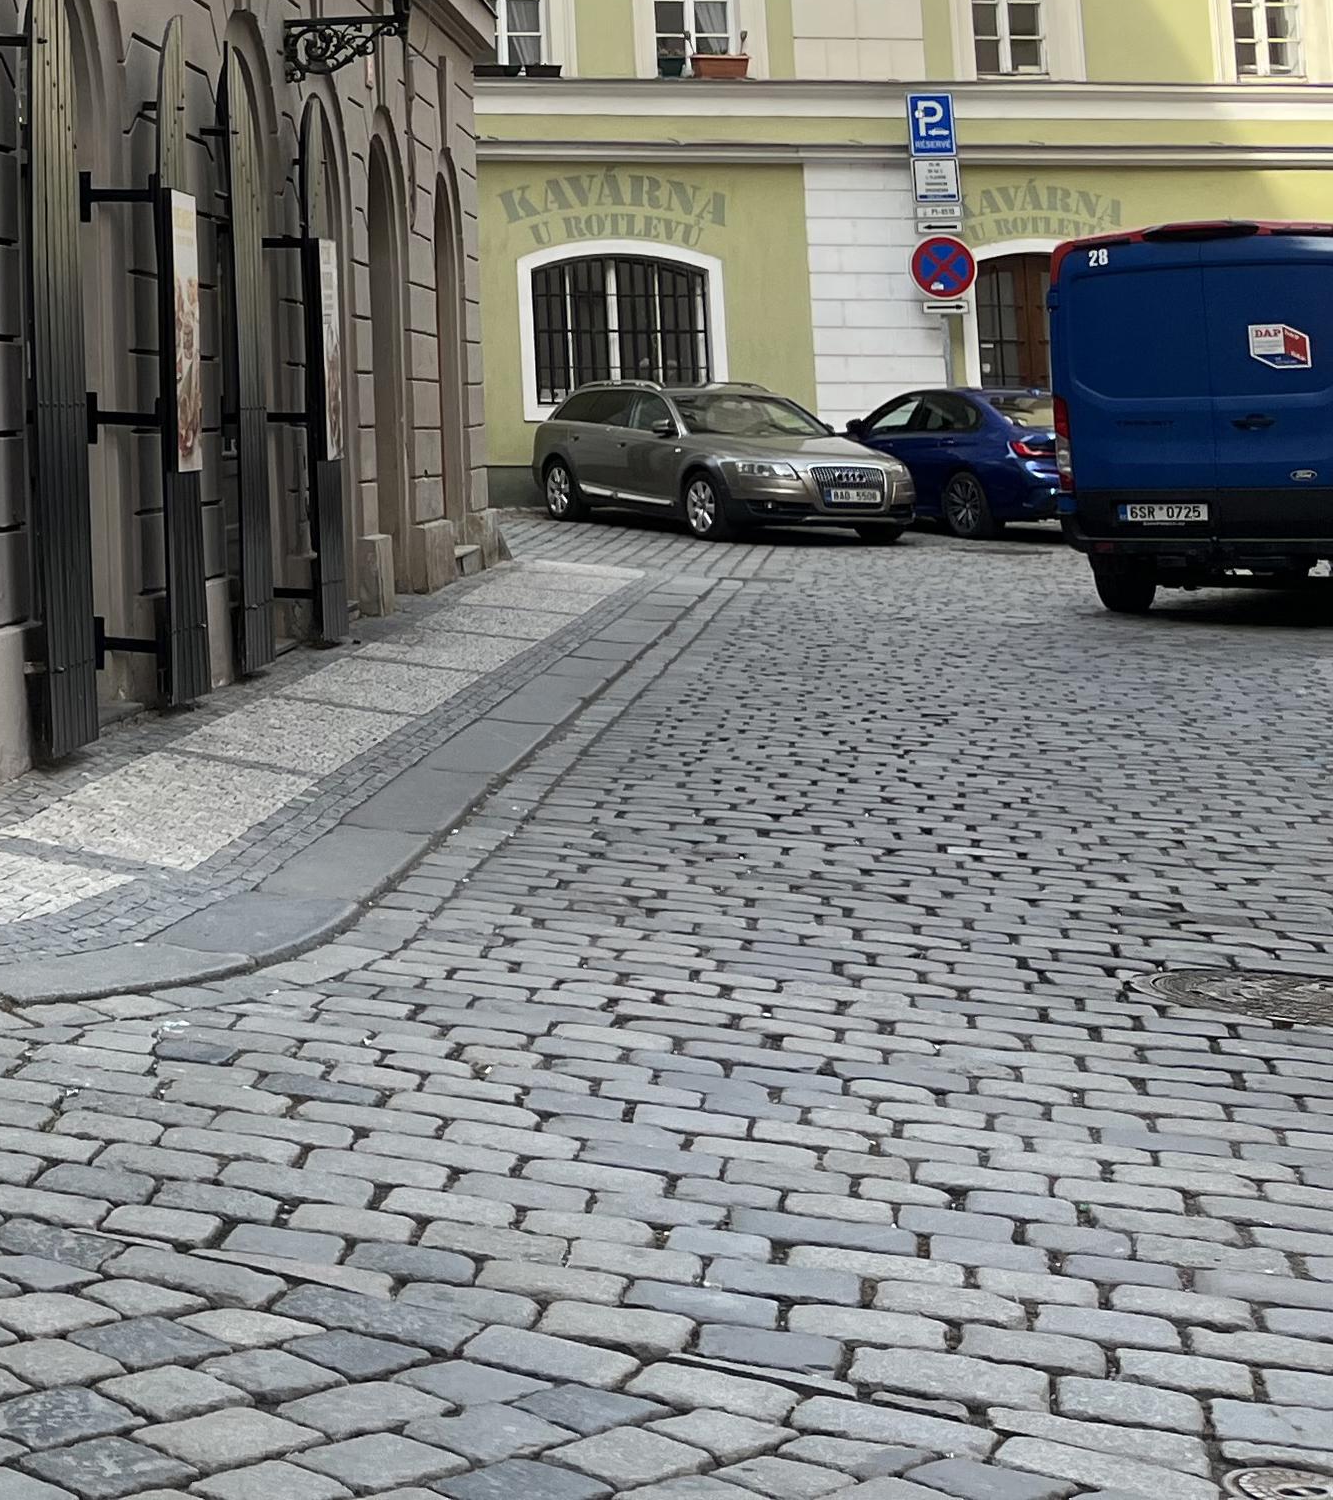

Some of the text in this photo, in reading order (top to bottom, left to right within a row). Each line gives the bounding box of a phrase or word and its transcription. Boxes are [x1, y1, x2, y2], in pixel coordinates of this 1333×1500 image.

[498, 164, 726, 227] KAVÁRNA
[530, 213, 704, 248] U ROTLEVŮ
[968, 224, 986, 242] U
[1088, 249, 1109, 267] 28
[1254, 329, 1281, 338] DAP
[1130, 506, 1201, 519] 6SR 0725
